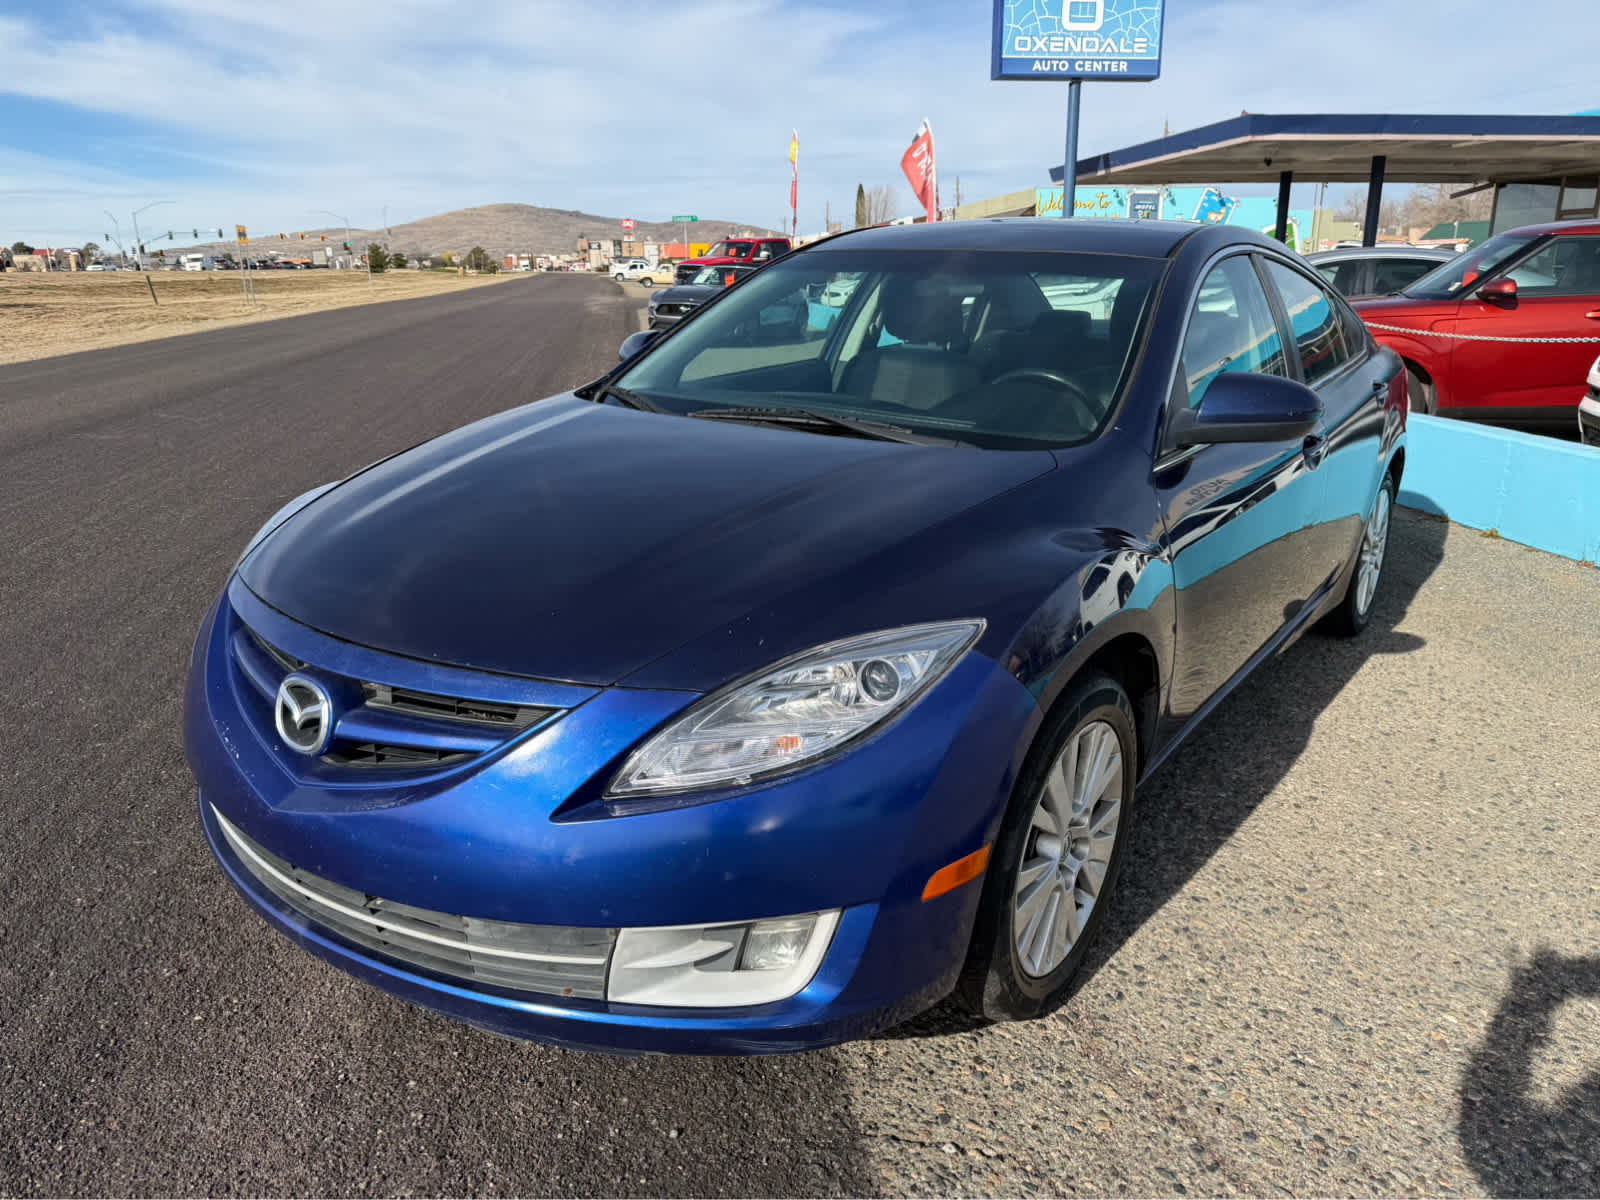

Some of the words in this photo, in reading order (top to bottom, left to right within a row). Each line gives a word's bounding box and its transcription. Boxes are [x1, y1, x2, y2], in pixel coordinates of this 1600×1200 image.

[1014, 36, 1148, 53] OXENDALE
[1032, 60, 1069, 72] AUTO
[1075, 60, 1128, 72] CENTER
[1096, 191, 1112, 208] to
